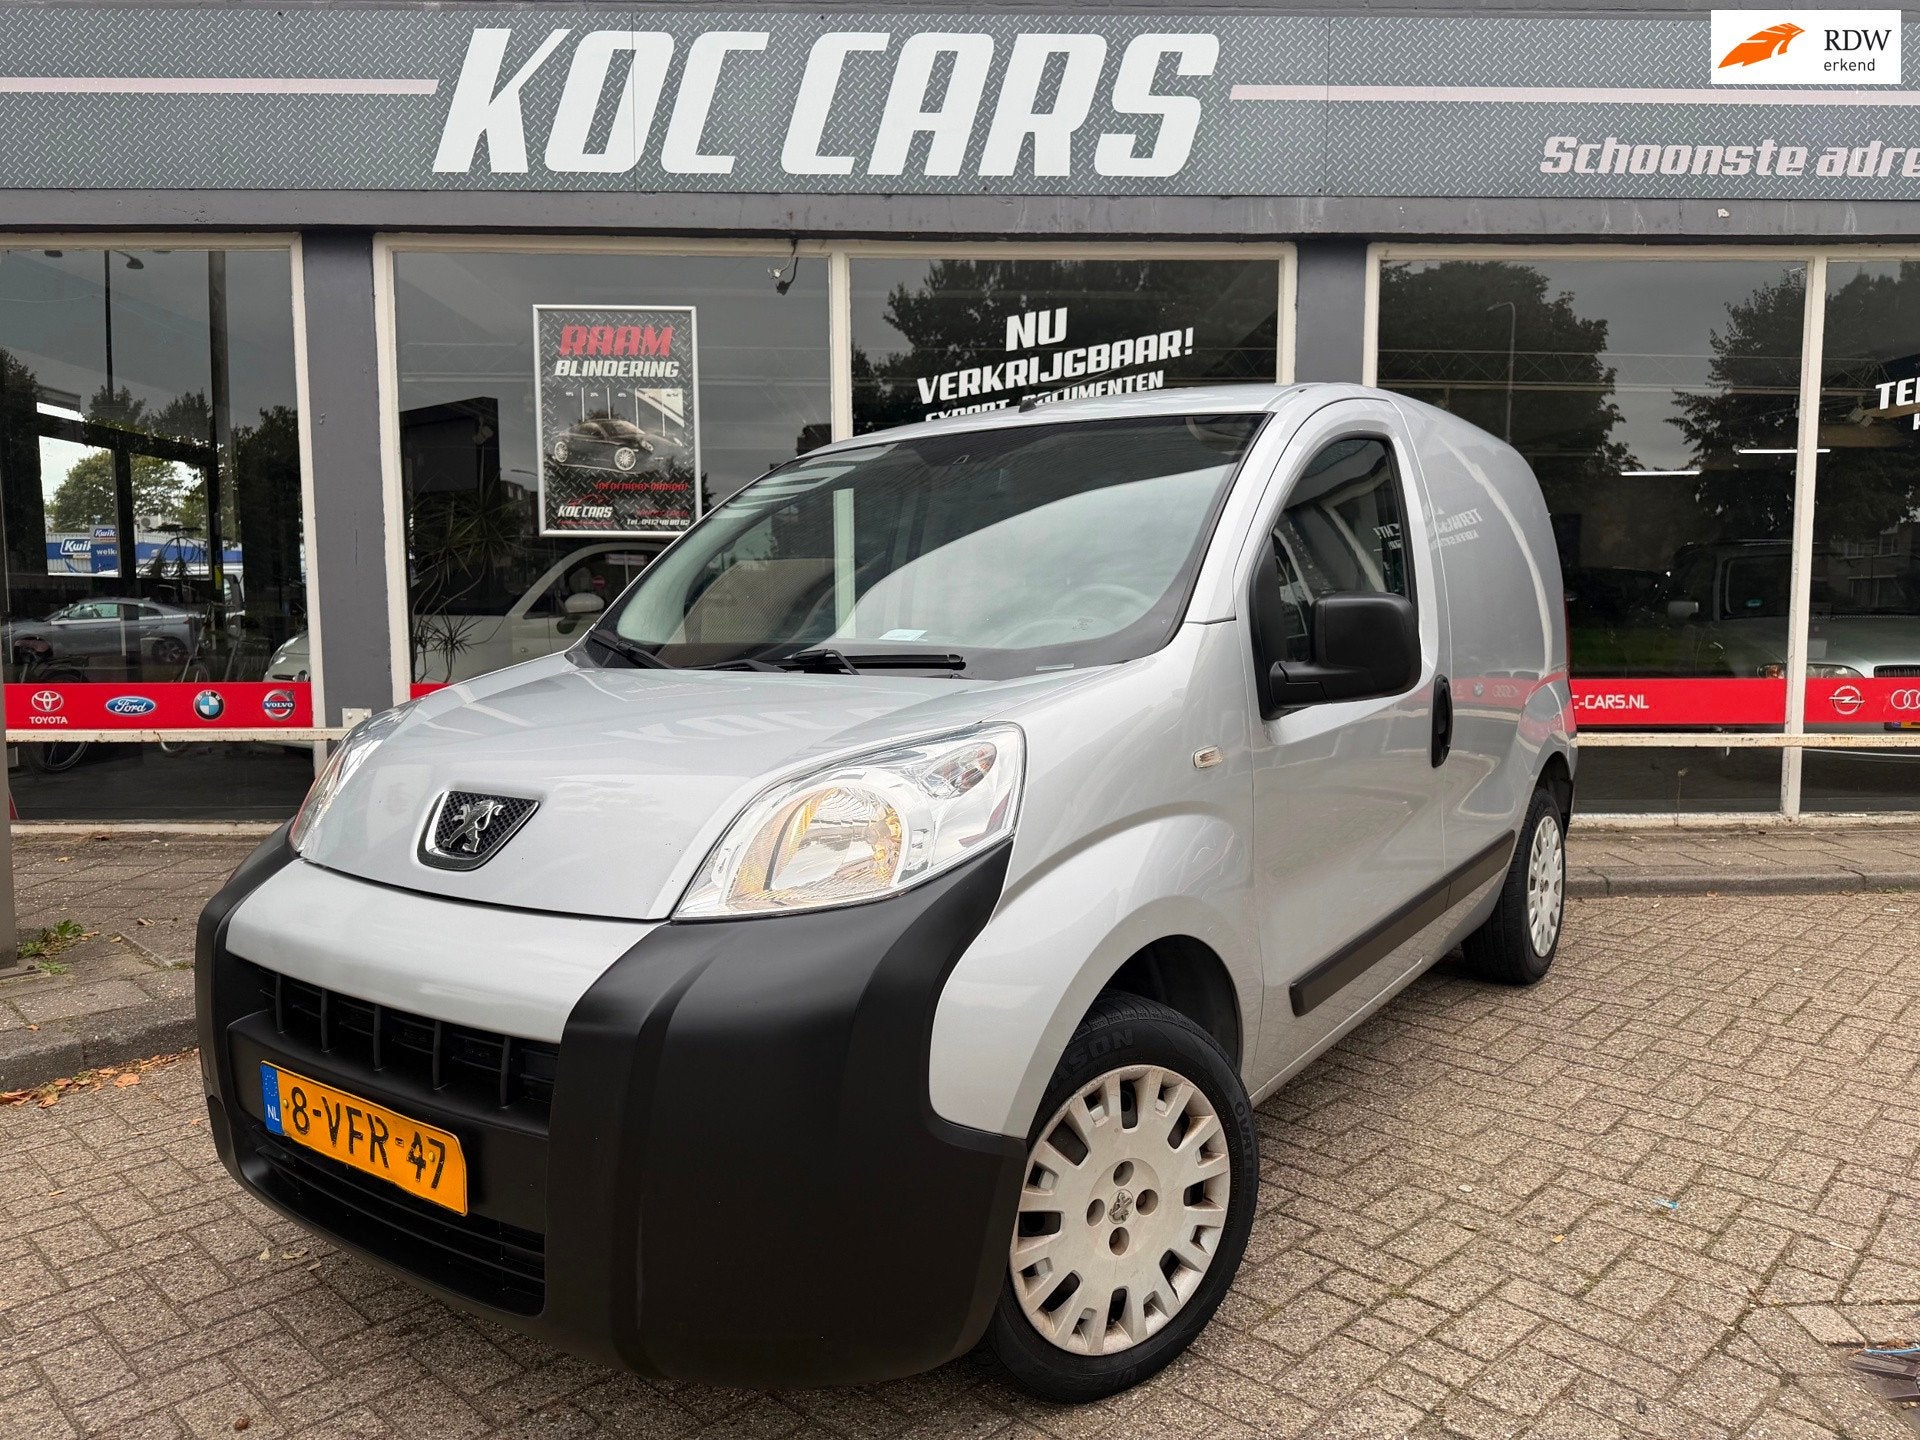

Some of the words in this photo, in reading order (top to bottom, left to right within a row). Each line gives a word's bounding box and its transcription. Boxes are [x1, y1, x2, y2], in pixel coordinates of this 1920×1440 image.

[432, 28, 771, 174] KOC
[781, 31, 1220, 178] CARS
[1540, 136, 1808, 176] Schoonste
[559, 324, 674, 357] RAAM
[1005, 307, 1068, 351] NU
[554, 360, 680, 378] BLINDERING
[916, 327, 1194, 405] VERKRIJGBAAR!
[1021, 370, 1164, 405] OCUMENTEN
[1875, 376, 1920, 410] TE
[581, 506, 613, 518] CARS
[29, 716, 68, 725] TOYOTA
[114, 698, 147, 713] Ford
[267, 1103, 280, 1122] NL
[291, 1086, 447, 1190] 8-VFR-47
